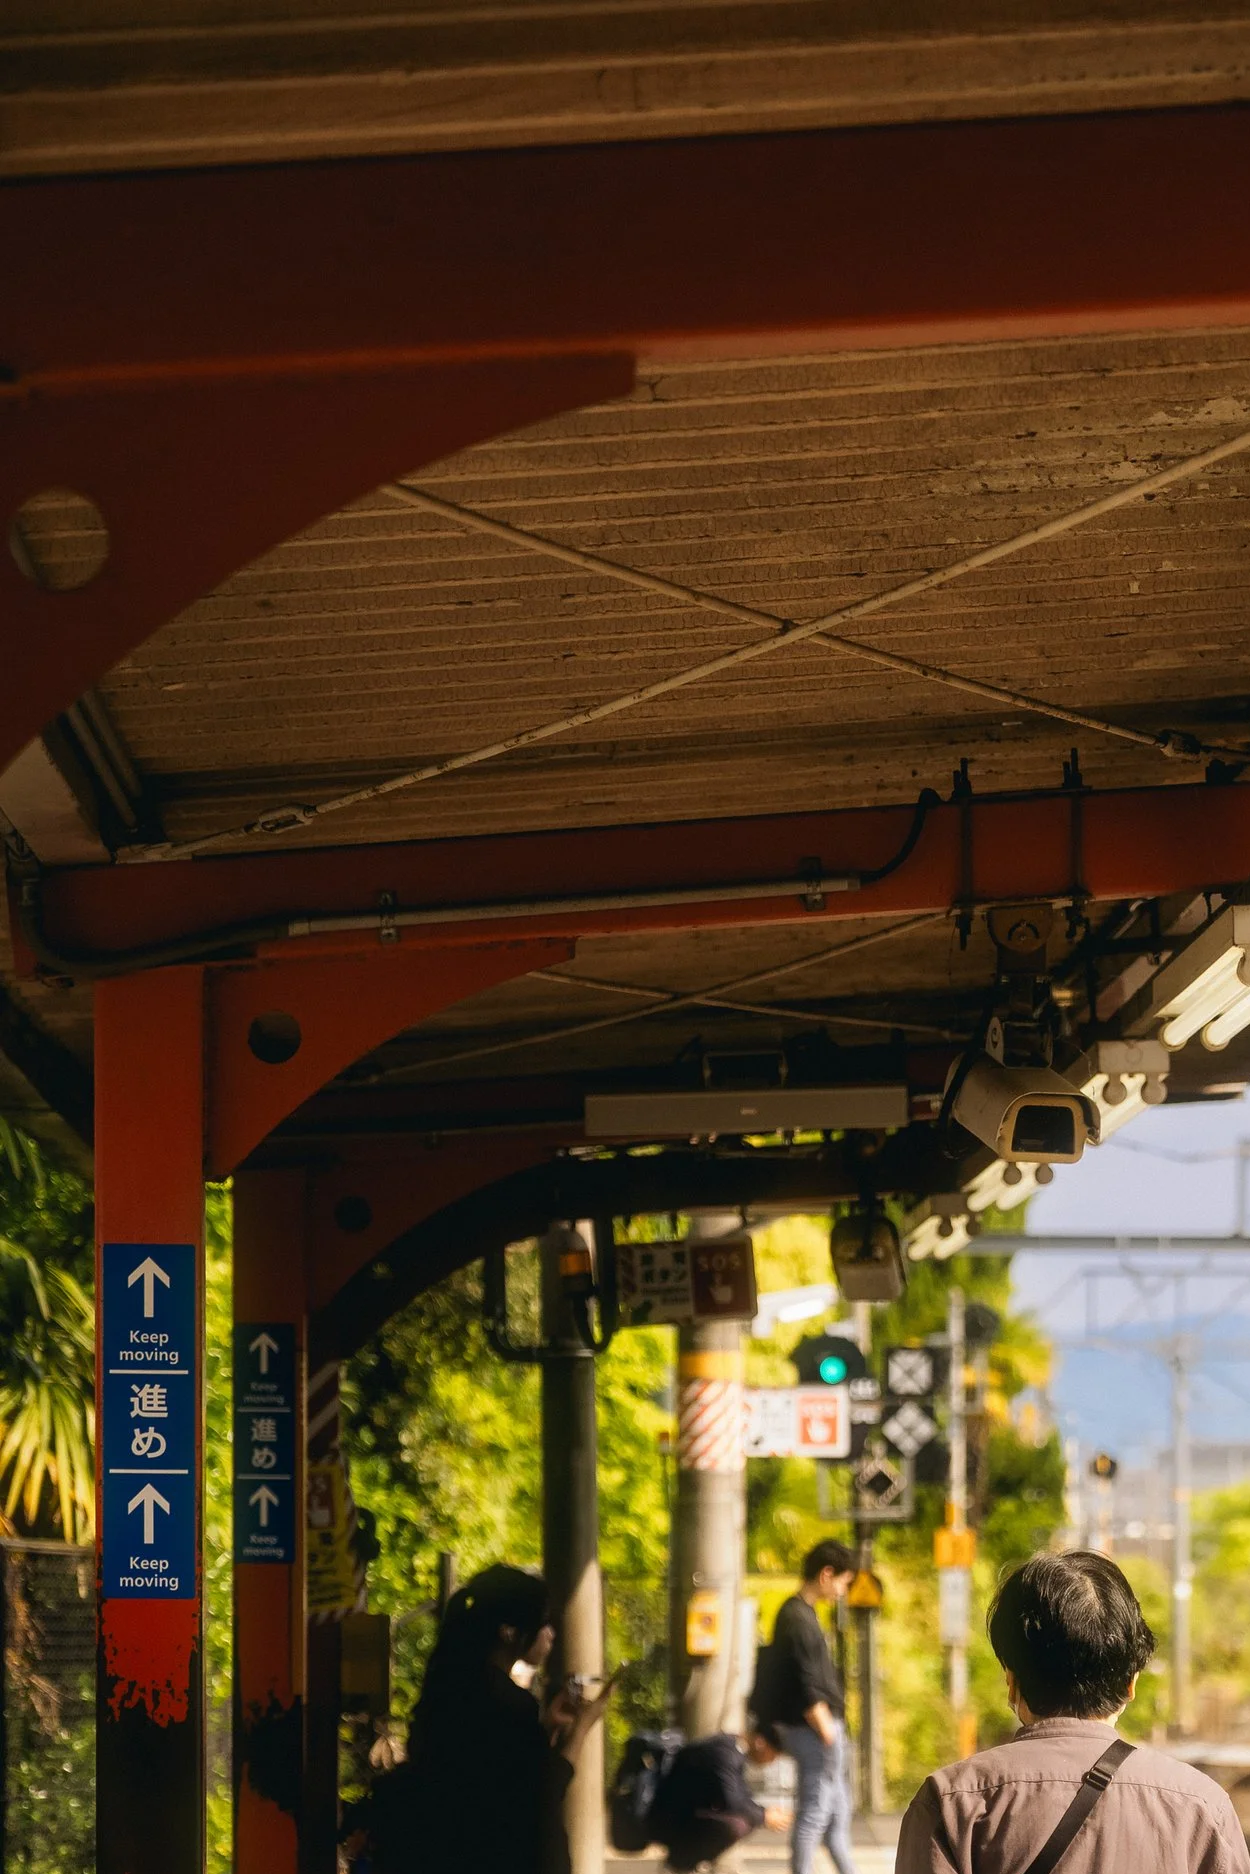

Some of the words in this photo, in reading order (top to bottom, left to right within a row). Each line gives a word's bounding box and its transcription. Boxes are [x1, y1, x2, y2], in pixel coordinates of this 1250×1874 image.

[129, 1330, 169, 1345] Keep
[119, 1347, 179, 1365] moving
[130, 1383, 169, 1459] 進め
[251, 1418, 277, 1469] 進め
[129, 1556, 169, 1572] Keep
[119, 1573, 179, 1591] moving
